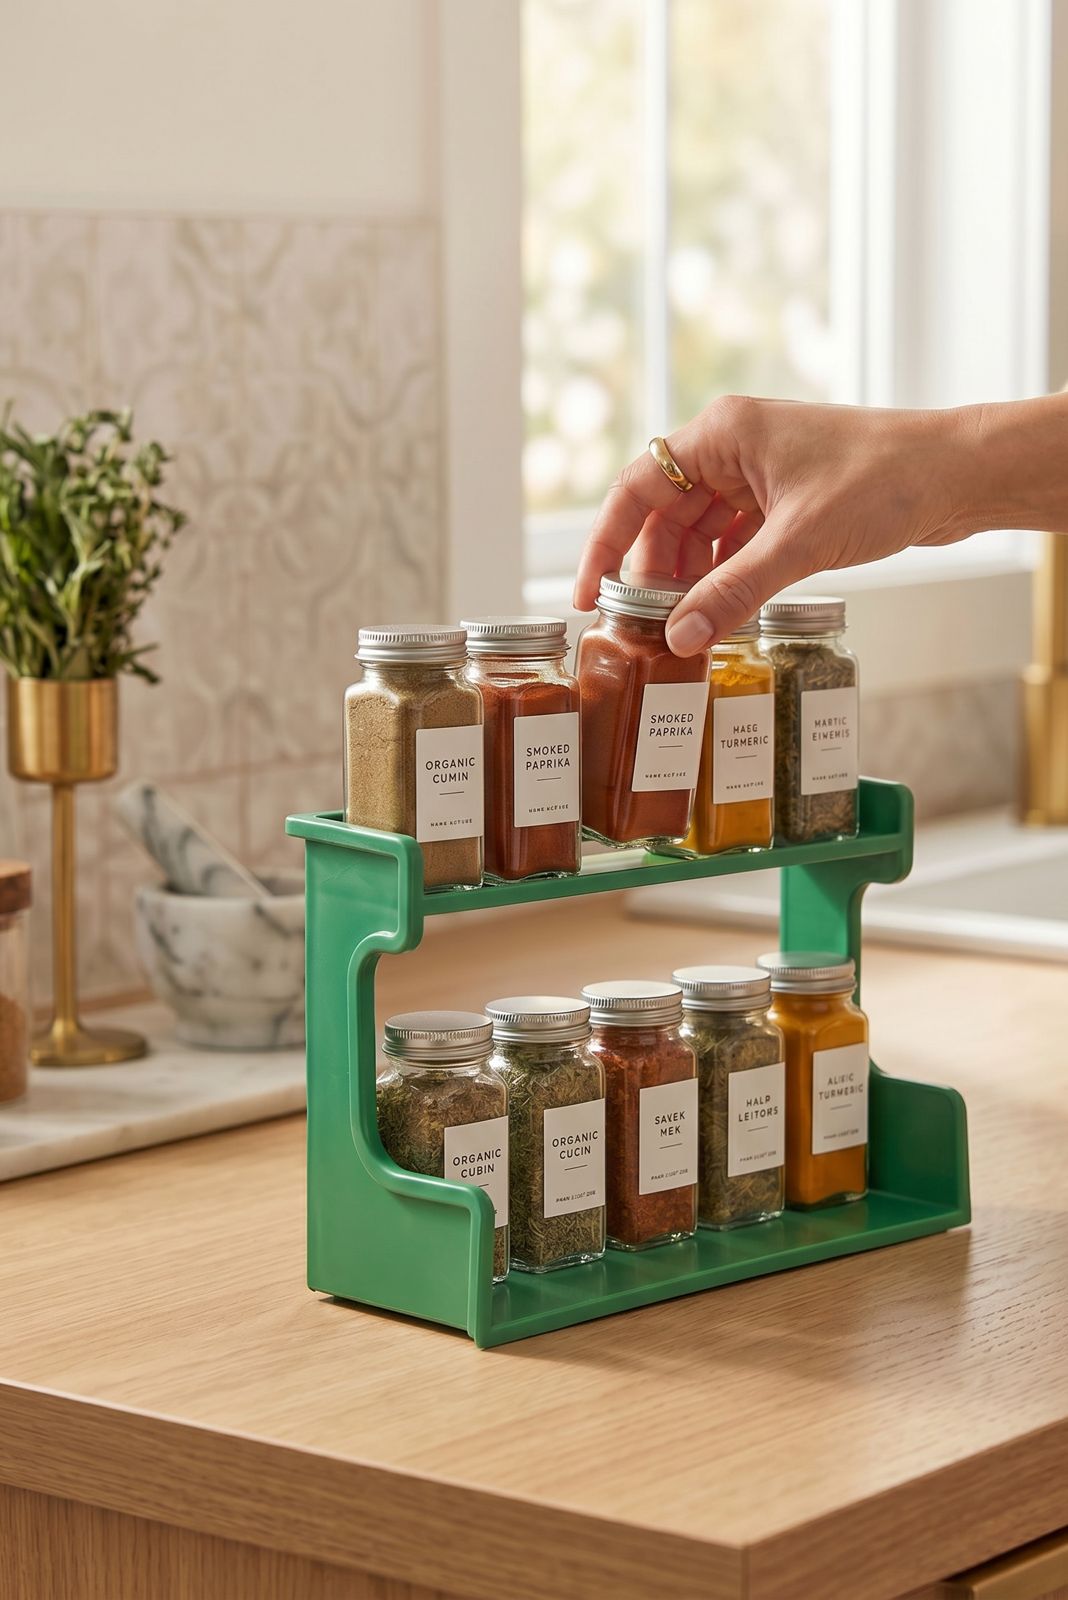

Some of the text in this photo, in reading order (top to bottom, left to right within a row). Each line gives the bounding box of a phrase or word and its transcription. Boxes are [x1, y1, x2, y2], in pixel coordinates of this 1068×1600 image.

[650, 713, 694, 724] SMOKED
[649, 726, 693, 737] PAPRIKA
[720, 736, 768, 749] TURMERIC
[526, 744, 570, 757] SMOKED
[425, 757, 475, 771] ORGANIC
[526, 758, 570, 771] PAPRIKA
[432, 772, 469, 783] CUMIN
[660, 1125, 681, 1137] MEK
[552, 1130, 598, 1148] ORGANIC
[453, 1148, 502, 1166] ORGANIC
[559, 1145, 591, 1160] CUCIN
[461, 1163, 495, 1178] CUBIN
